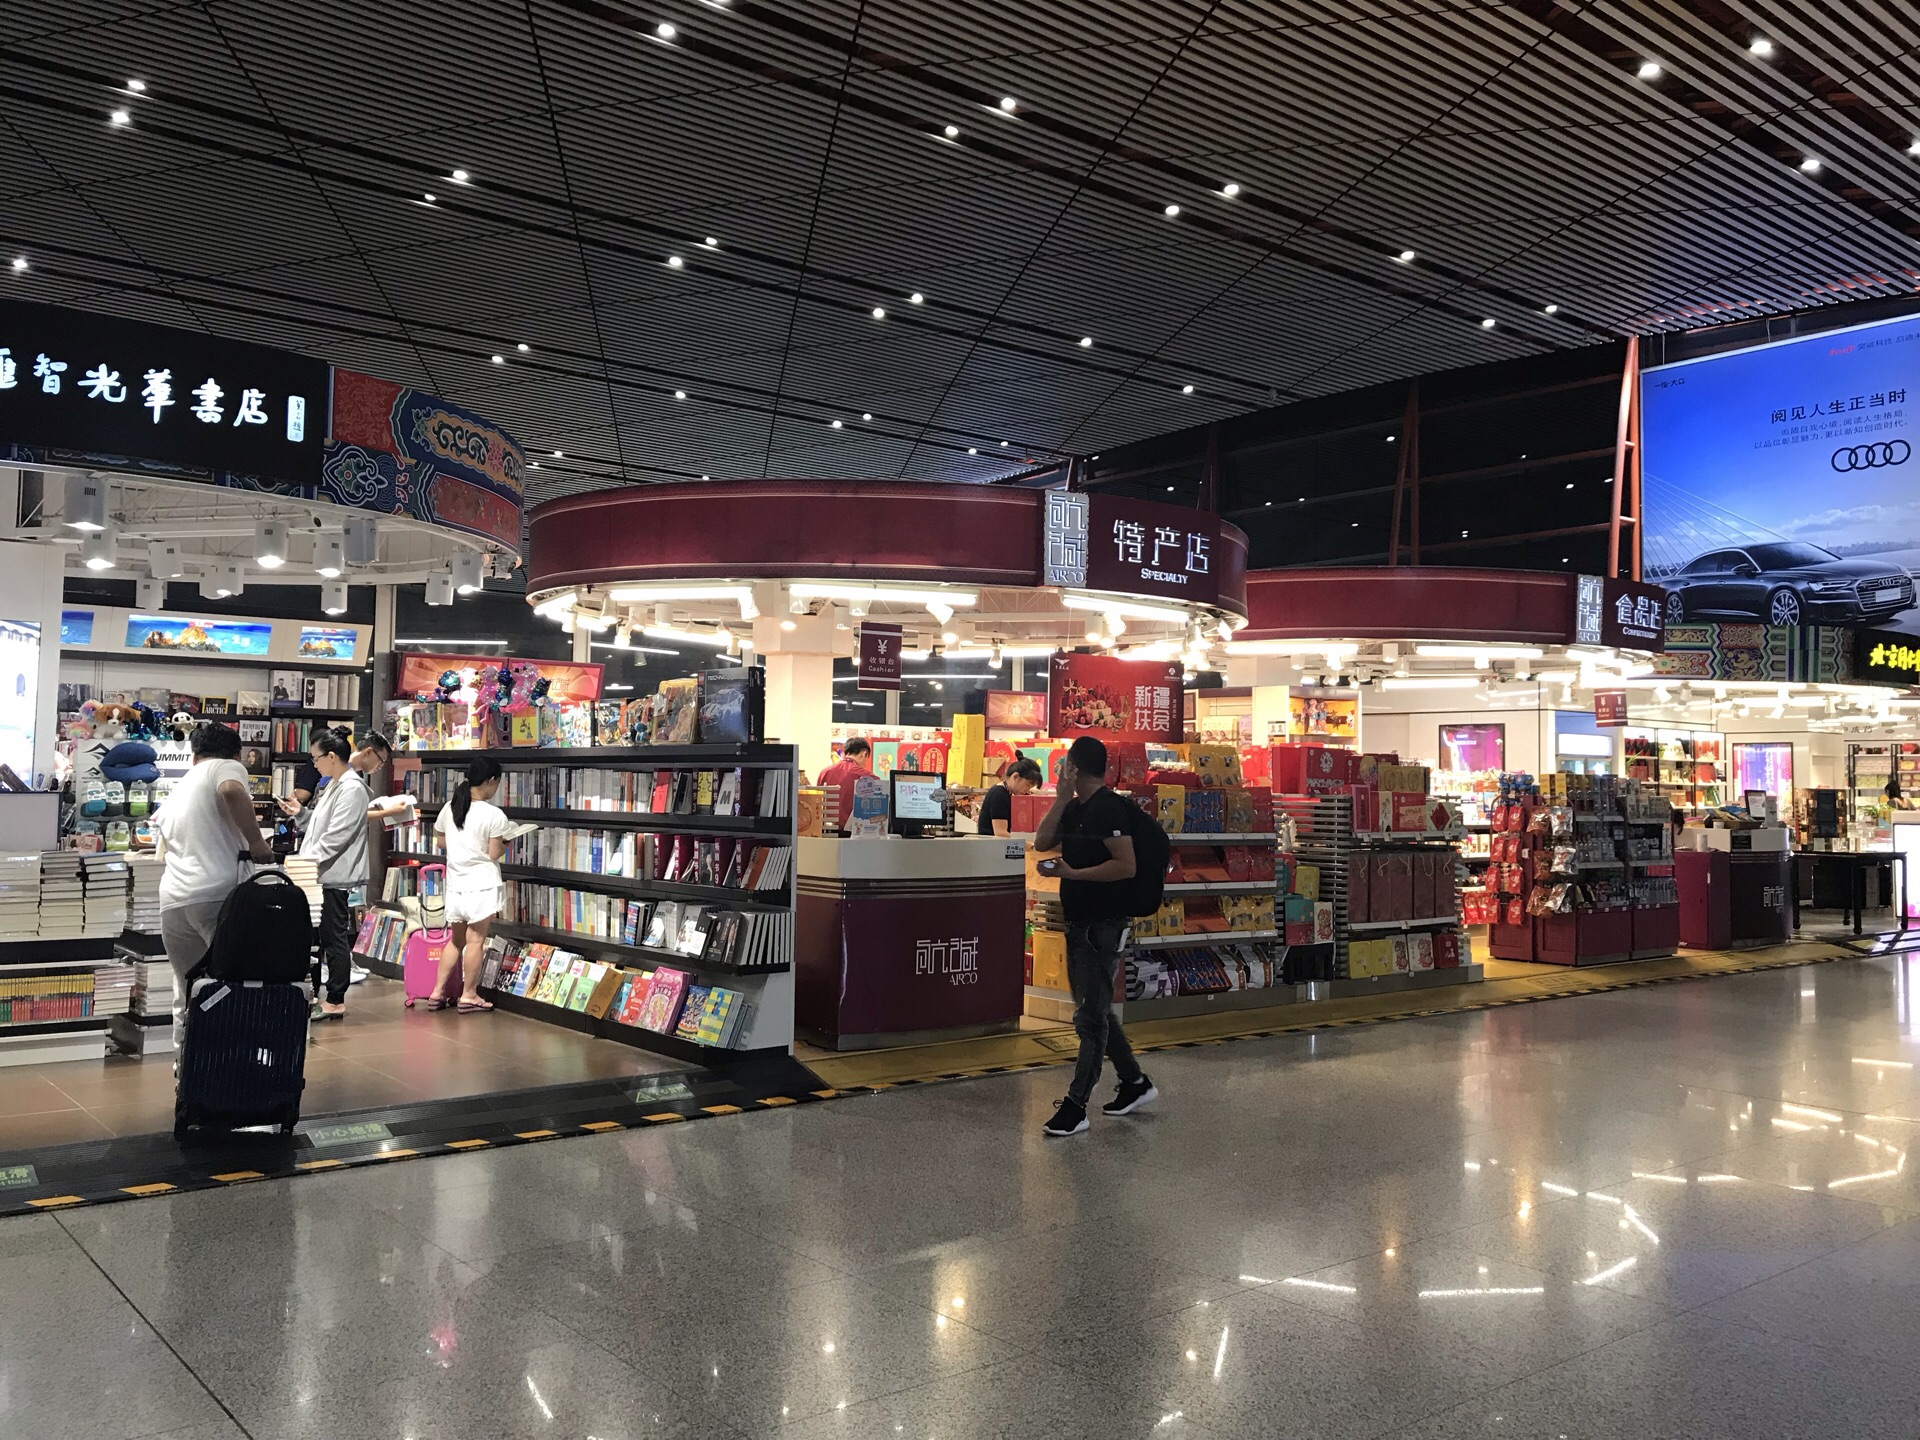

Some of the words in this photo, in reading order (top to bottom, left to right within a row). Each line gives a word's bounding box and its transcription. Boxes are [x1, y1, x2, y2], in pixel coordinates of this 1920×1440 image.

[1770, 388, 1907, 425] 阅见人生正当时
[1113, 518, 1211, 574] 特产店
[1615, 593, 1663, 630] 食品店
[868, 656, 895, 666] 收银台
[868, 665, 895, 673] Cashier
[1134, 685, 1170, 709] 新疆
[203, 706, 226, 715] ARCTIC
[1134, 709, 1170, 732] 扶贫
[154, 753, 191, 762] UMMIT
[915, 936, 979, 975] 航诚
[949, 972, 978, 986] AIRCO
[314, 1122, 382, 1140] 小心地滑
[7, 1178, 32, 1186] floor
